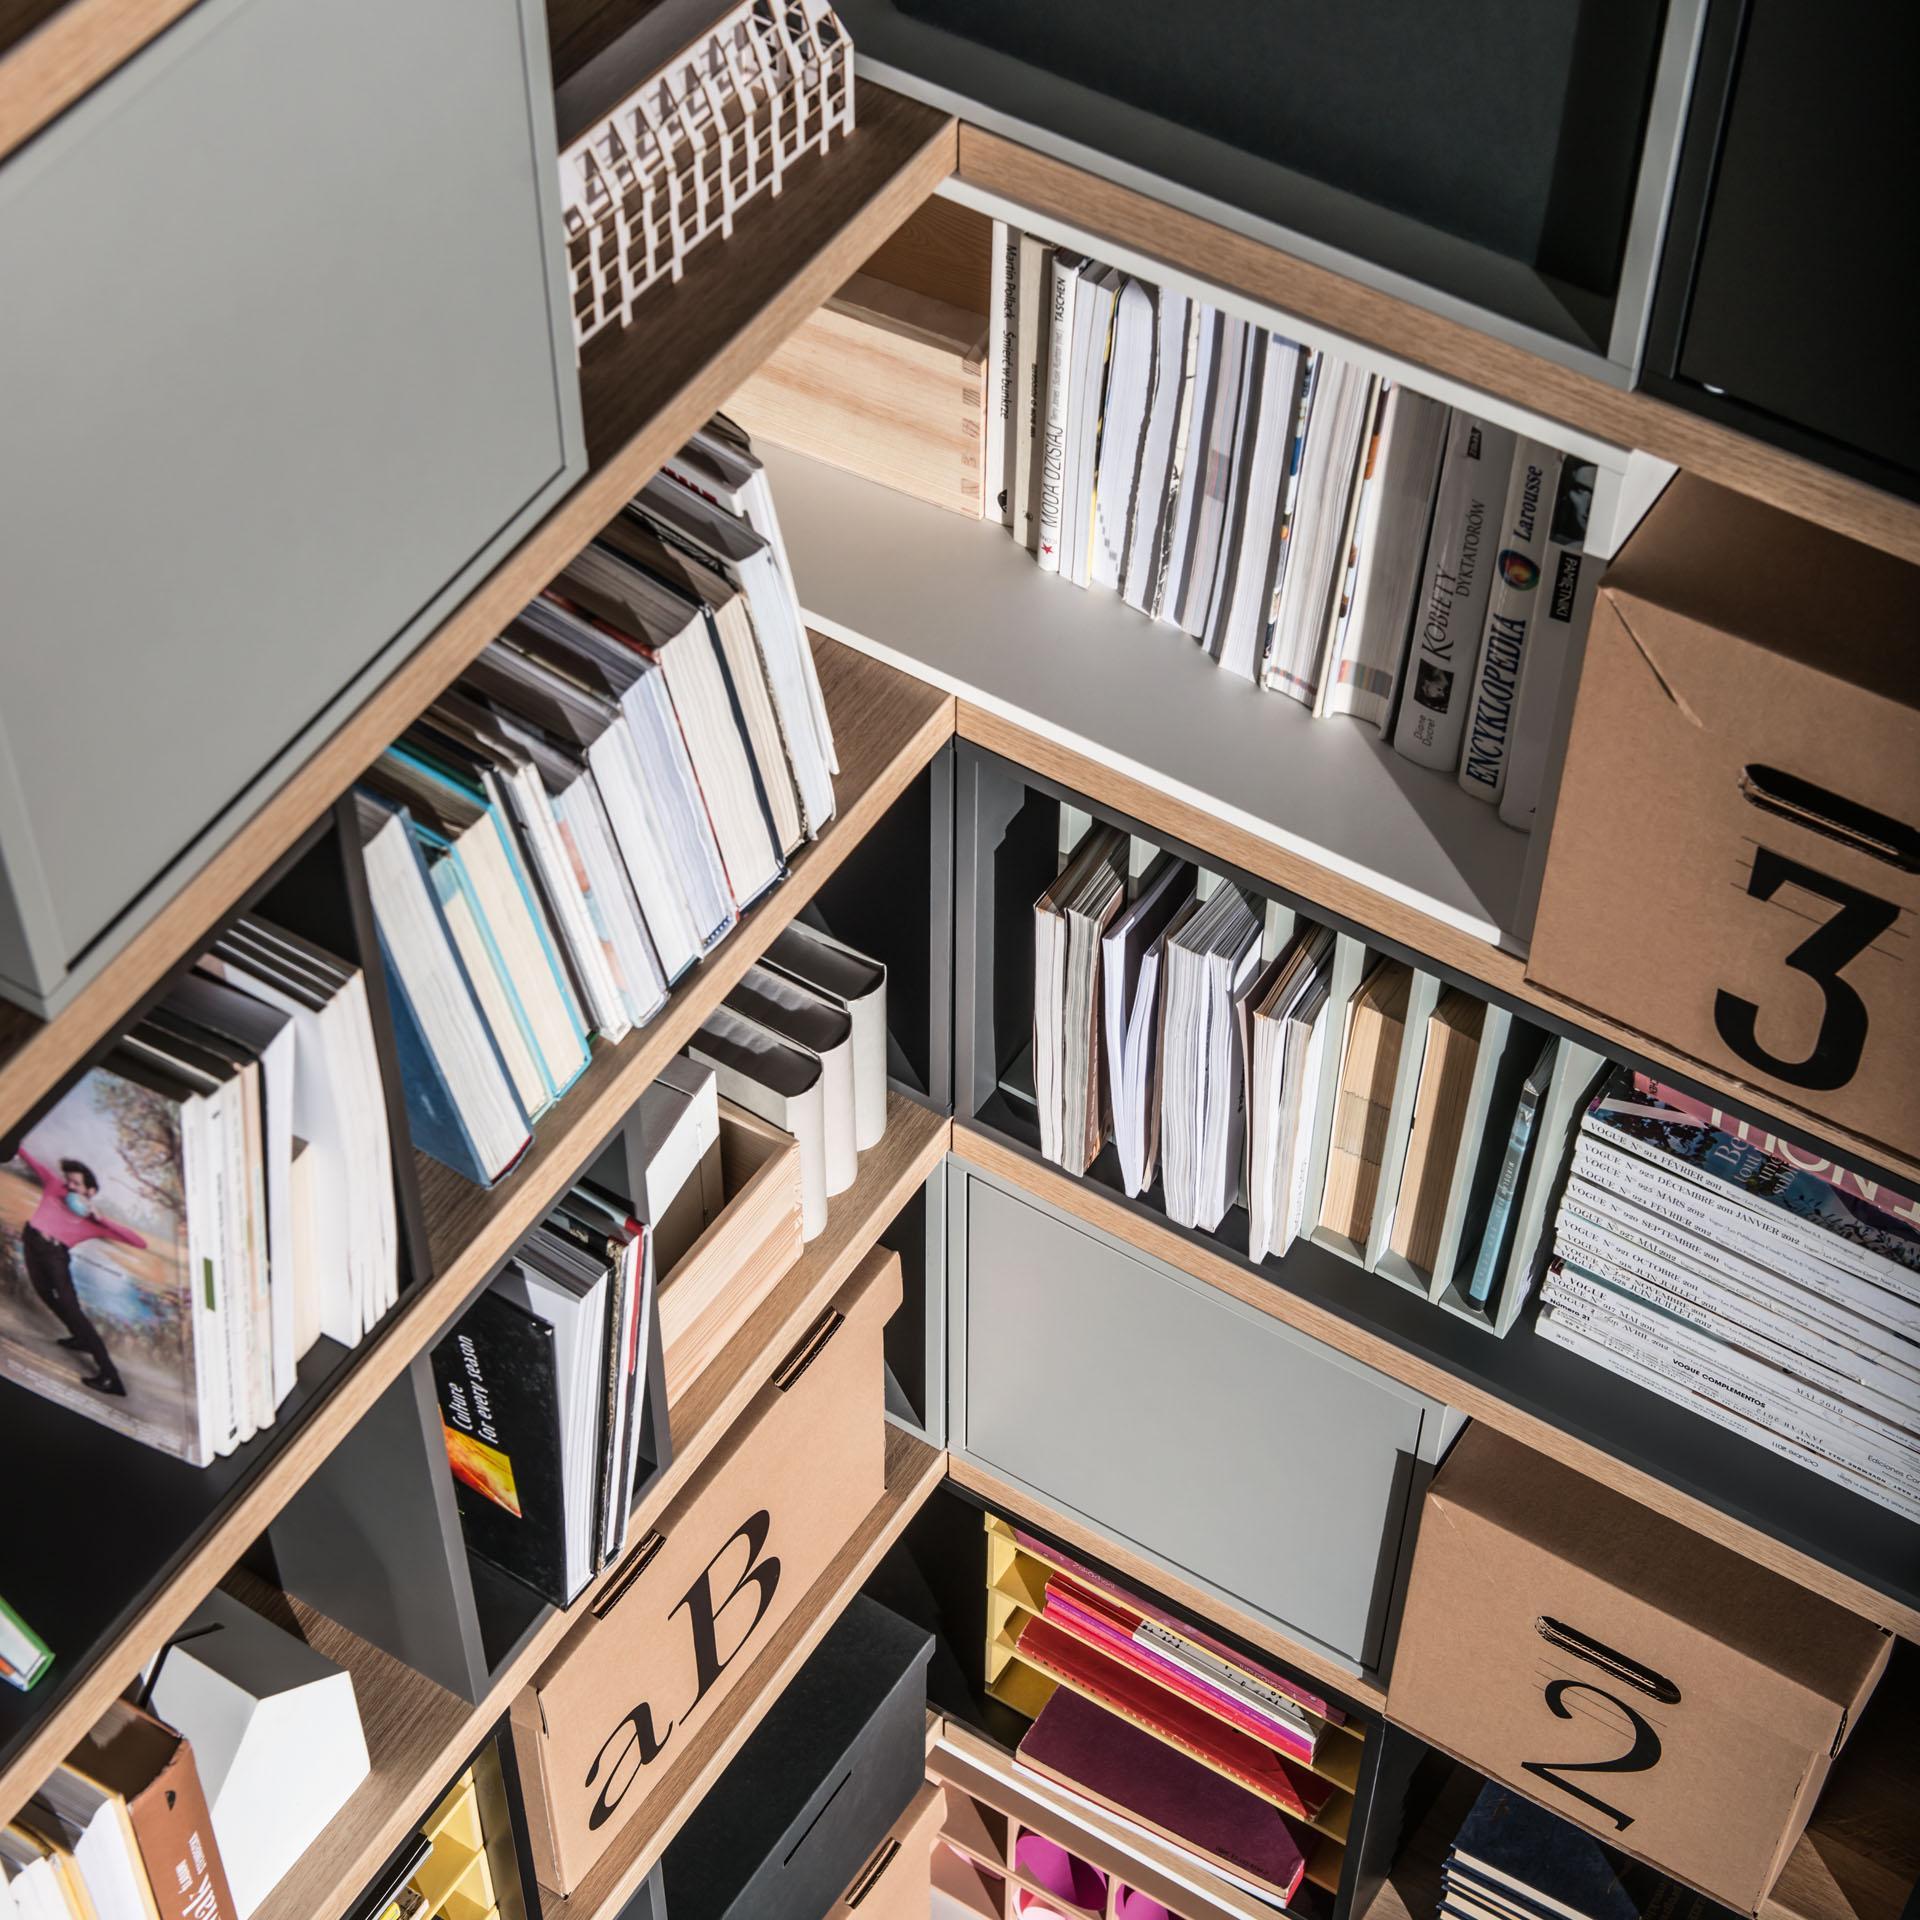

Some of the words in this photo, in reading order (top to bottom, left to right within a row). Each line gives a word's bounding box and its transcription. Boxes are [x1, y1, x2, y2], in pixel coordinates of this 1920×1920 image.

[1005, 244, 1016, 279] Martin
[1003, 282, 1015, 319] Pollack
[1056, 278, 1066, 322] TASCHEN
[1001, 330, 1015, 365] Śmierć
[1002, 367, 1009, 376] w
[1000, 377, 1012, 419] bunkrze
[1043, 421, 1063, 479] DZISIAJ
[1040, 484, 1058, 527] MODA
[1513, 465, 1544, 543] Larousse
[1456, 499, 1485, 596] DYKTATORÓW
[1421, 562, 1454, 661] KOBIETY
[1466, 613, 1526, 788] ENCYKLOPEDIA
[1714, 846, 1900, 1091] 3
[1582, 1155, 1622, 1178] VOGUE
[1655, 1189, 1687, 1209] MARS
[1685, 1205, 1706, 1219] 2012
[1588, 1121, 1627, 1145] VOGUE
[1642, 1149, 1658, 1160] 914
[1659, 1154, 1705, 1182] FÉVRIER
[1704, 1178, 1722, 1191] 2011
[1568, 1183, 1608, 1207] VOGUE
[1639, 1218, 1703, 1254] SEPTEMBRE
[1701, 1250, 1720, 1263] 2011
[1577, 1166, 1616, 1189] VOGUE
[1648, 1199, 1694, 1227] FÉVRIER
[1692, 1223, 1712, 1237] 2012
[1582, 1142, 1622, 1166] VOGUE
[1656, 1174, 1716, 1207] DÉCEMBRE
[1715, 1202, 1734, 1215] 2011
[1734, 1210, 1780, 1236] JANVIER
[1779, 1232, 1800, 1245] 2012
[1561, 1218, 1600, 1242] VOGUE
[1630, 1253, 1682, 1283] OCTOBRE
[1681, 1279, 1699, 1291] 2011
[1565, 1202, 1603, 1225] VOGUE
[1618, 1229, 1635, 1241] 927
[1636, 1237, 1658, 1252] MAI
[1657, 1248, 1677, 1262] 2012
[1549, 1275, 1588, 1299] VOGUE
[1618, 1310, 1639, 1325] MAI
[1638, 1321, 1656, 1333] 2011
[1558, 1249, 1595, 1271] VOGUE
[1628, 1283, 1652, 1299] JUIN
[1652, 1295, 1694, 1319] JUILLET
[1692, 1316, 1712, 1329] 2012
[1562, 1243, 1600, 1266] VOGUE
[1633, 1278, 1690, 1309] NOVEMBRE
[1565, 1233, 1603, 1255] VOGUE
[1634, 1266, 1658, 1282] JUIN
[1658, 1277, 1700, 1302] JUILLET
[1699, 1299, 1718, 1311] 2011
[1551, 1288, 1591, 1312] VOGUE
[1621, 1323, 1648, 1340] AVRIL
[1650, 1337, 1670, 1351] 2012
[1567, 1277, 1608, 1301] VOGUE
[1794, 1387, 1816, 1401] MAI
[1818, 1398, 1844, 1415] 2010
[458, 1335, 482, 1382] season
[1548, 1297, 1580, 1316] Número
[1580, 1313, 1591, 1321] 21
[1671, 1358, 1701, 1376] VOGUE
[1700, 1372, 1767, 1409] COMPLEMENTOS
[1866, 1454, 1905, 1477] Ediciones
[449, 1383, 472, 1431] Culture
[471, 1378, 492, 1420] every
[478, 1421, 498, 1445] for
[1770, 1440, 1787, 1452] 2011
[1785, 1447, 1819, 1468] Octubre
[585, 1509, 780, 1831] aB
[1521, 1680, 1661, 1831] 2
